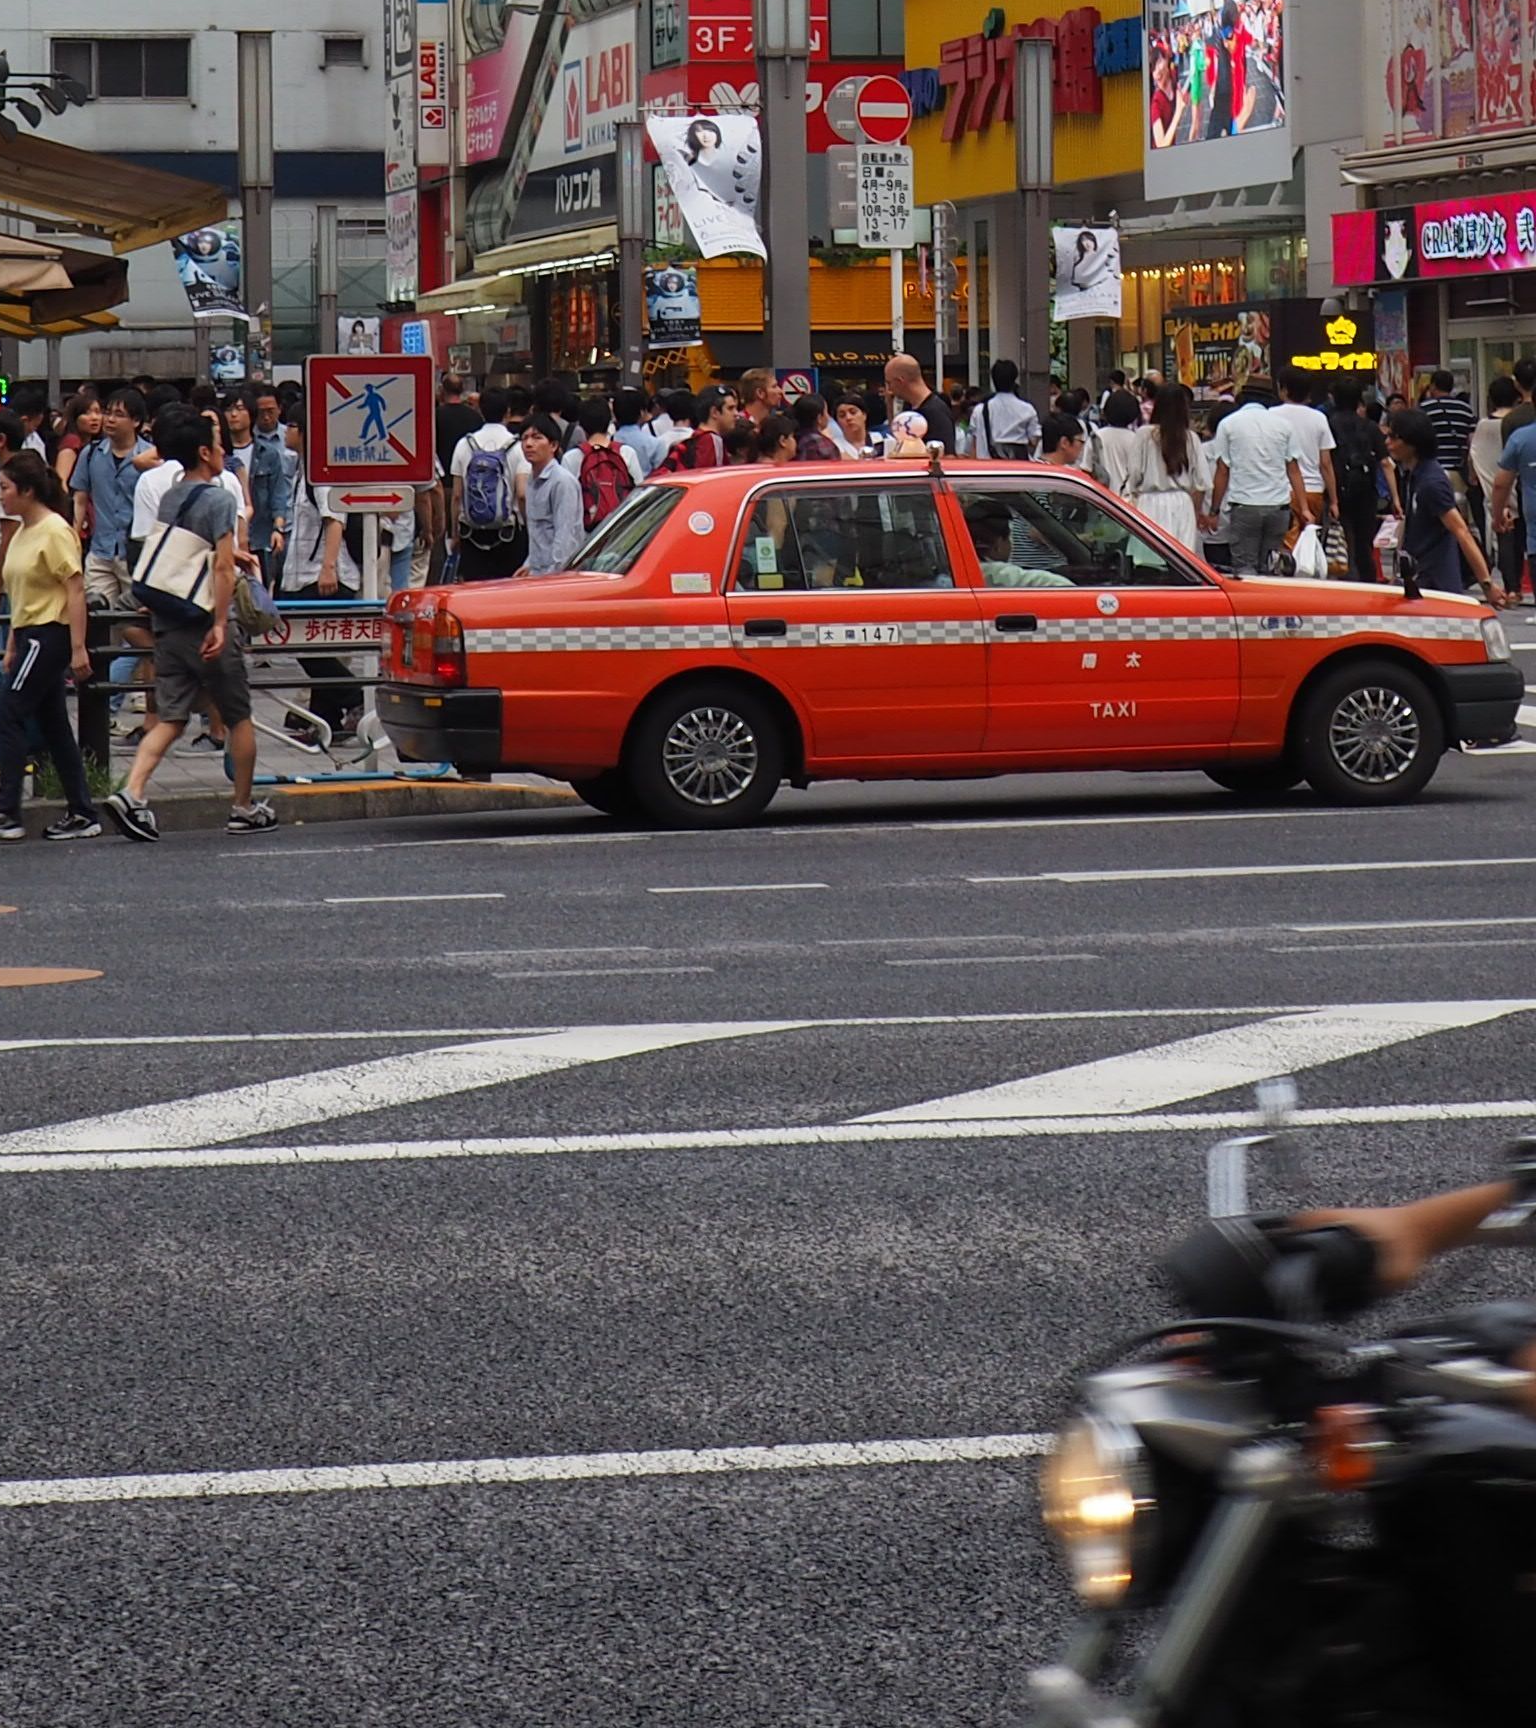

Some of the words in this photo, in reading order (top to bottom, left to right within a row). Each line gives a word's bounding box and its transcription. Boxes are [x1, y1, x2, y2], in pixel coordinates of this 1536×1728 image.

[695, 26, 737, 53] 3F
[420, 41, 438, 102] LABI
[585, 42, 633, 115] LABI
[333, 445, 392, 464] 横断禁止
[861, 626, 898, 643] 147
[1089, 701, 1138, 719] TAXI
